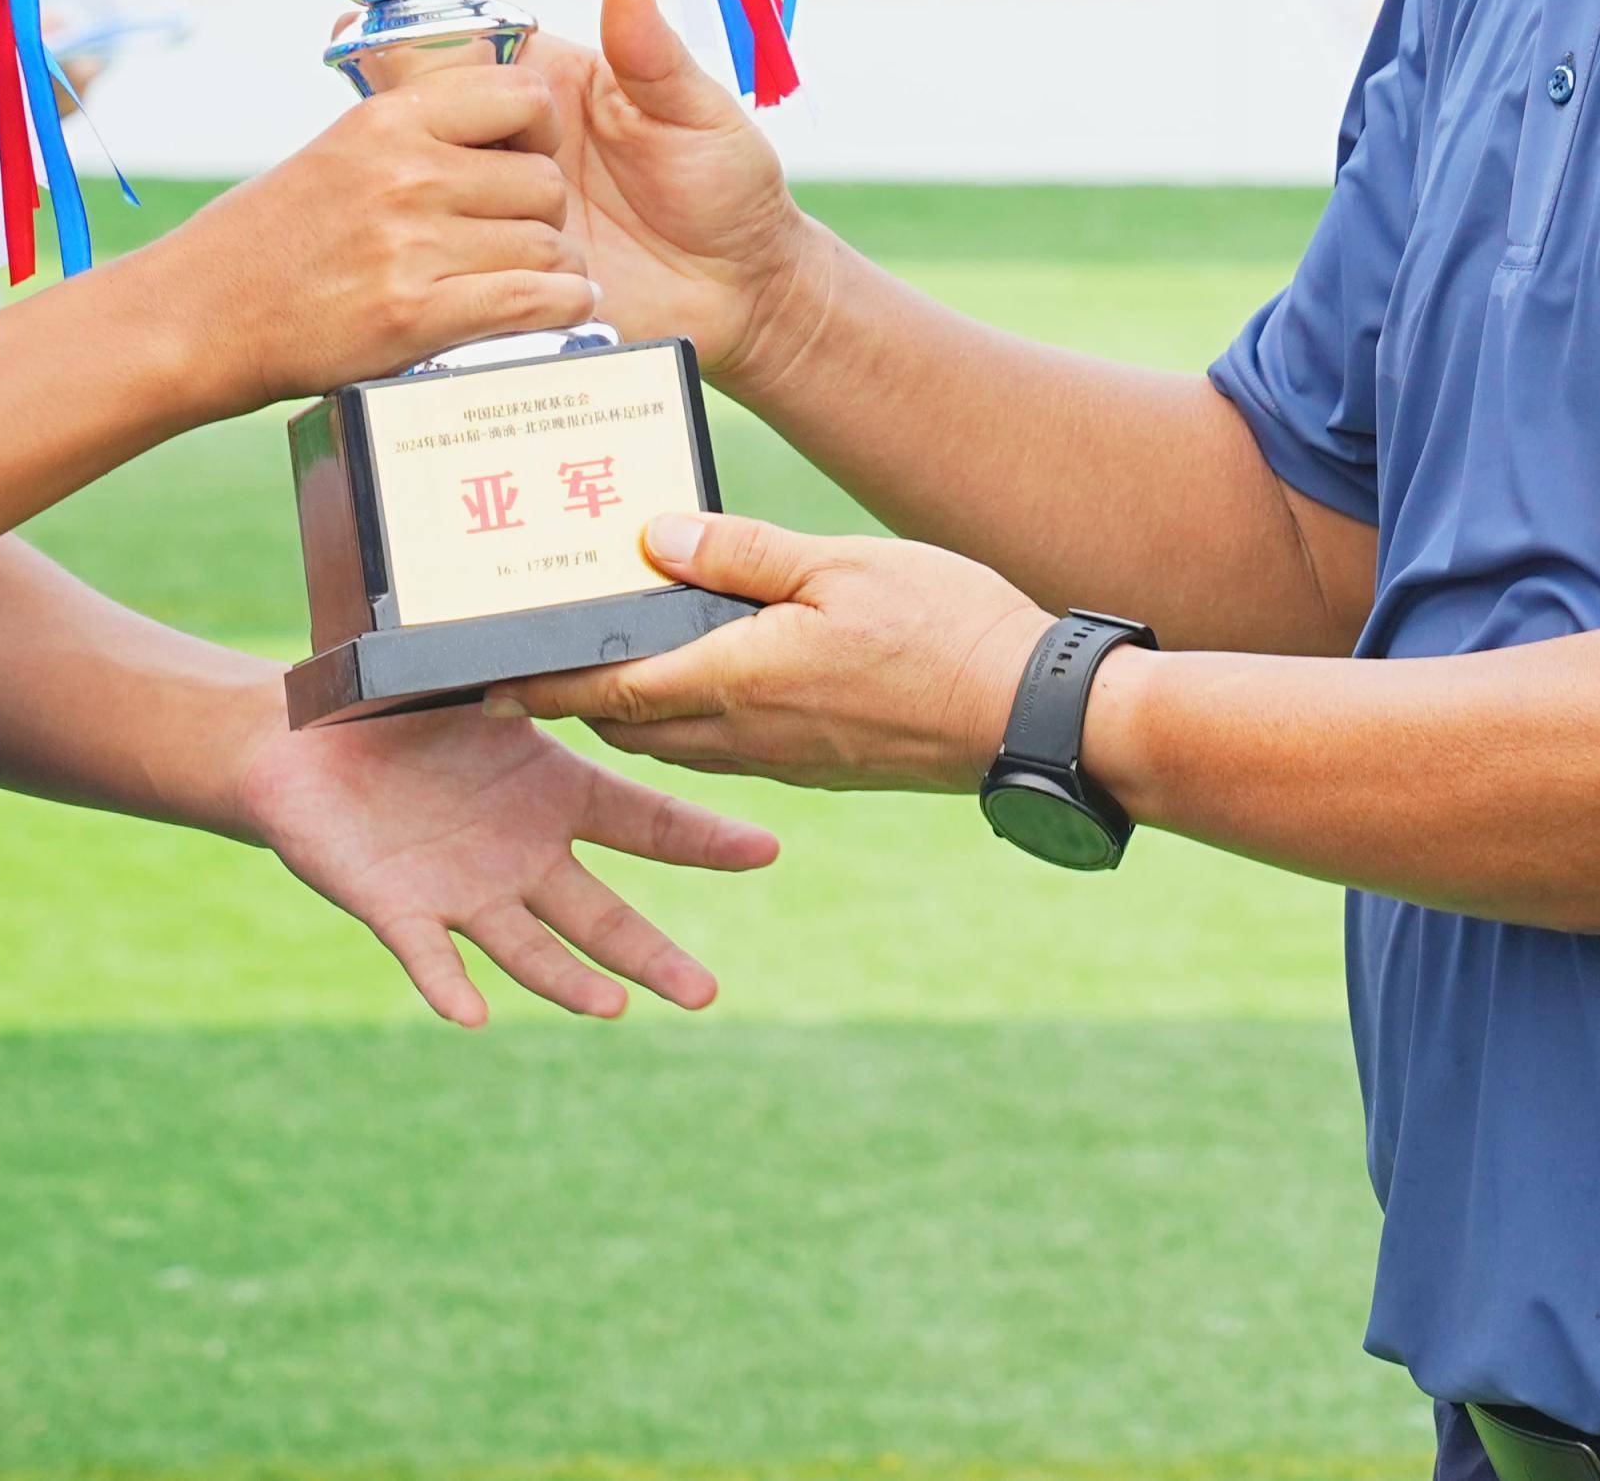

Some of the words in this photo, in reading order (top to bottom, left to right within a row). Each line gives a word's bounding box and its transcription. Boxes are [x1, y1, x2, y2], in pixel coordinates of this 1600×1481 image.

[463, 392, 590, 423] 中国足球发展基金会
[461, 455, 623, 534] 亚军
